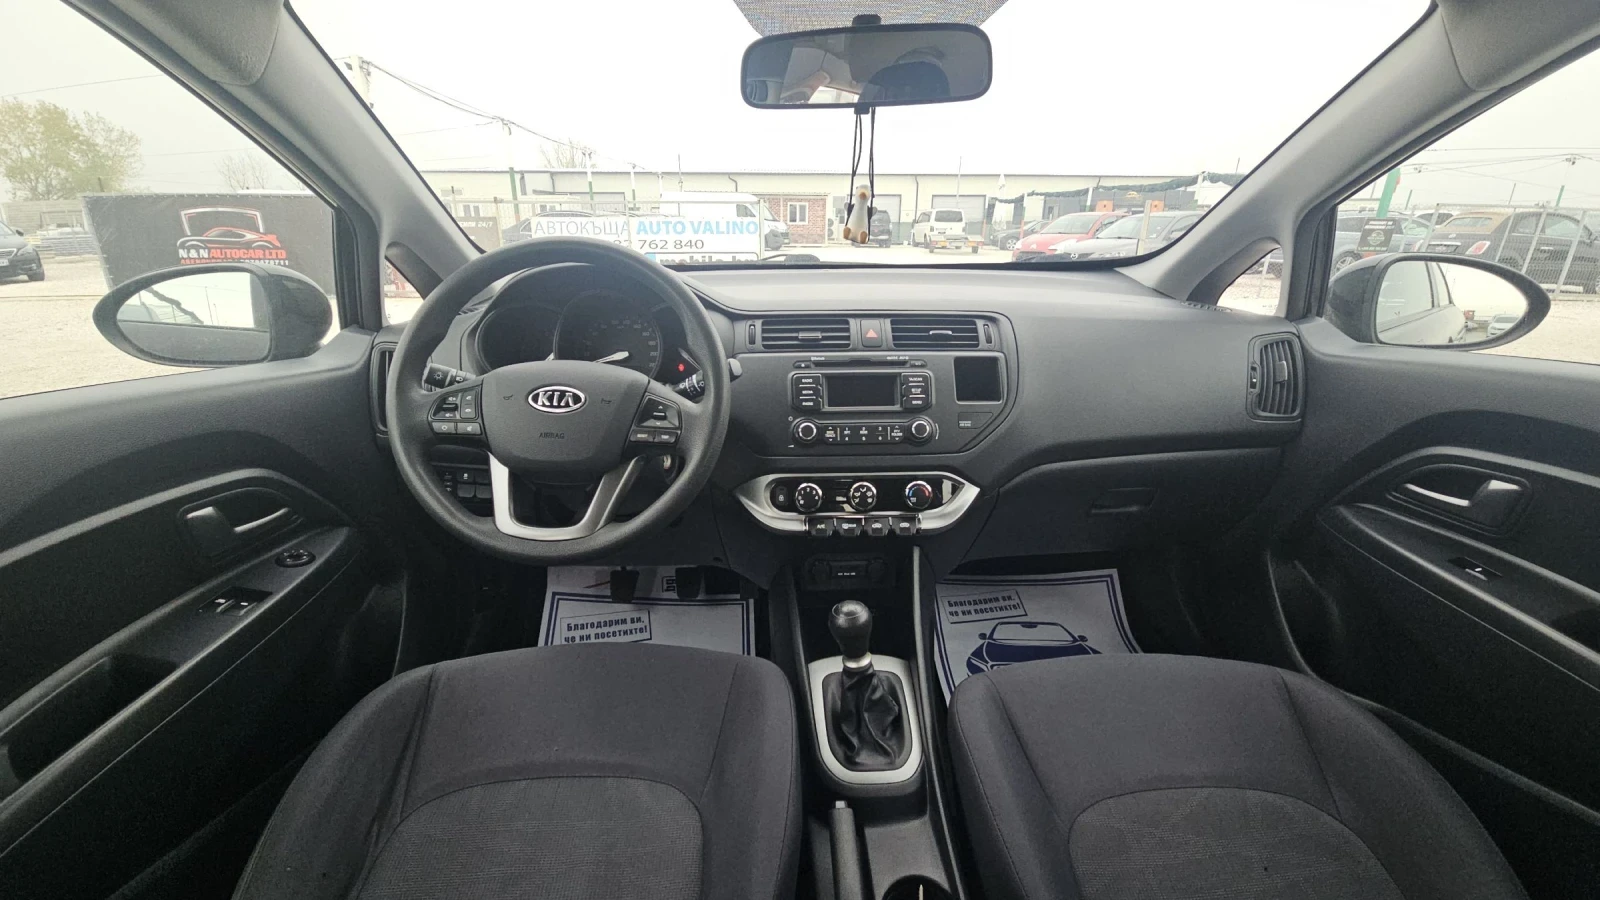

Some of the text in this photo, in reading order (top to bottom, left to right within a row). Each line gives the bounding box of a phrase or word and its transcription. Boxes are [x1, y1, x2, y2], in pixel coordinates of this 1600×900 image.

[534, 220, 629, 237] АВТОКЪЩА
[636, 220, 759, 235] AUTO VALINO
[638, 239, 668, 250] 762
[673, 239, 705, 250] 840
[210, 248, 264, 259] AUTOCAR
[265, 249, 287, 259] LTD
[537, 391, 575, 407] KIA
[539, 432, 565, 440] AIRBAG
[947, 596, 1001, 608] Благодарим
[974, 602, 1021, 615] посетихте!
[566, 617, 628, 632] Благодарим
[564, 625, 648, 643] че ни посетихте!
